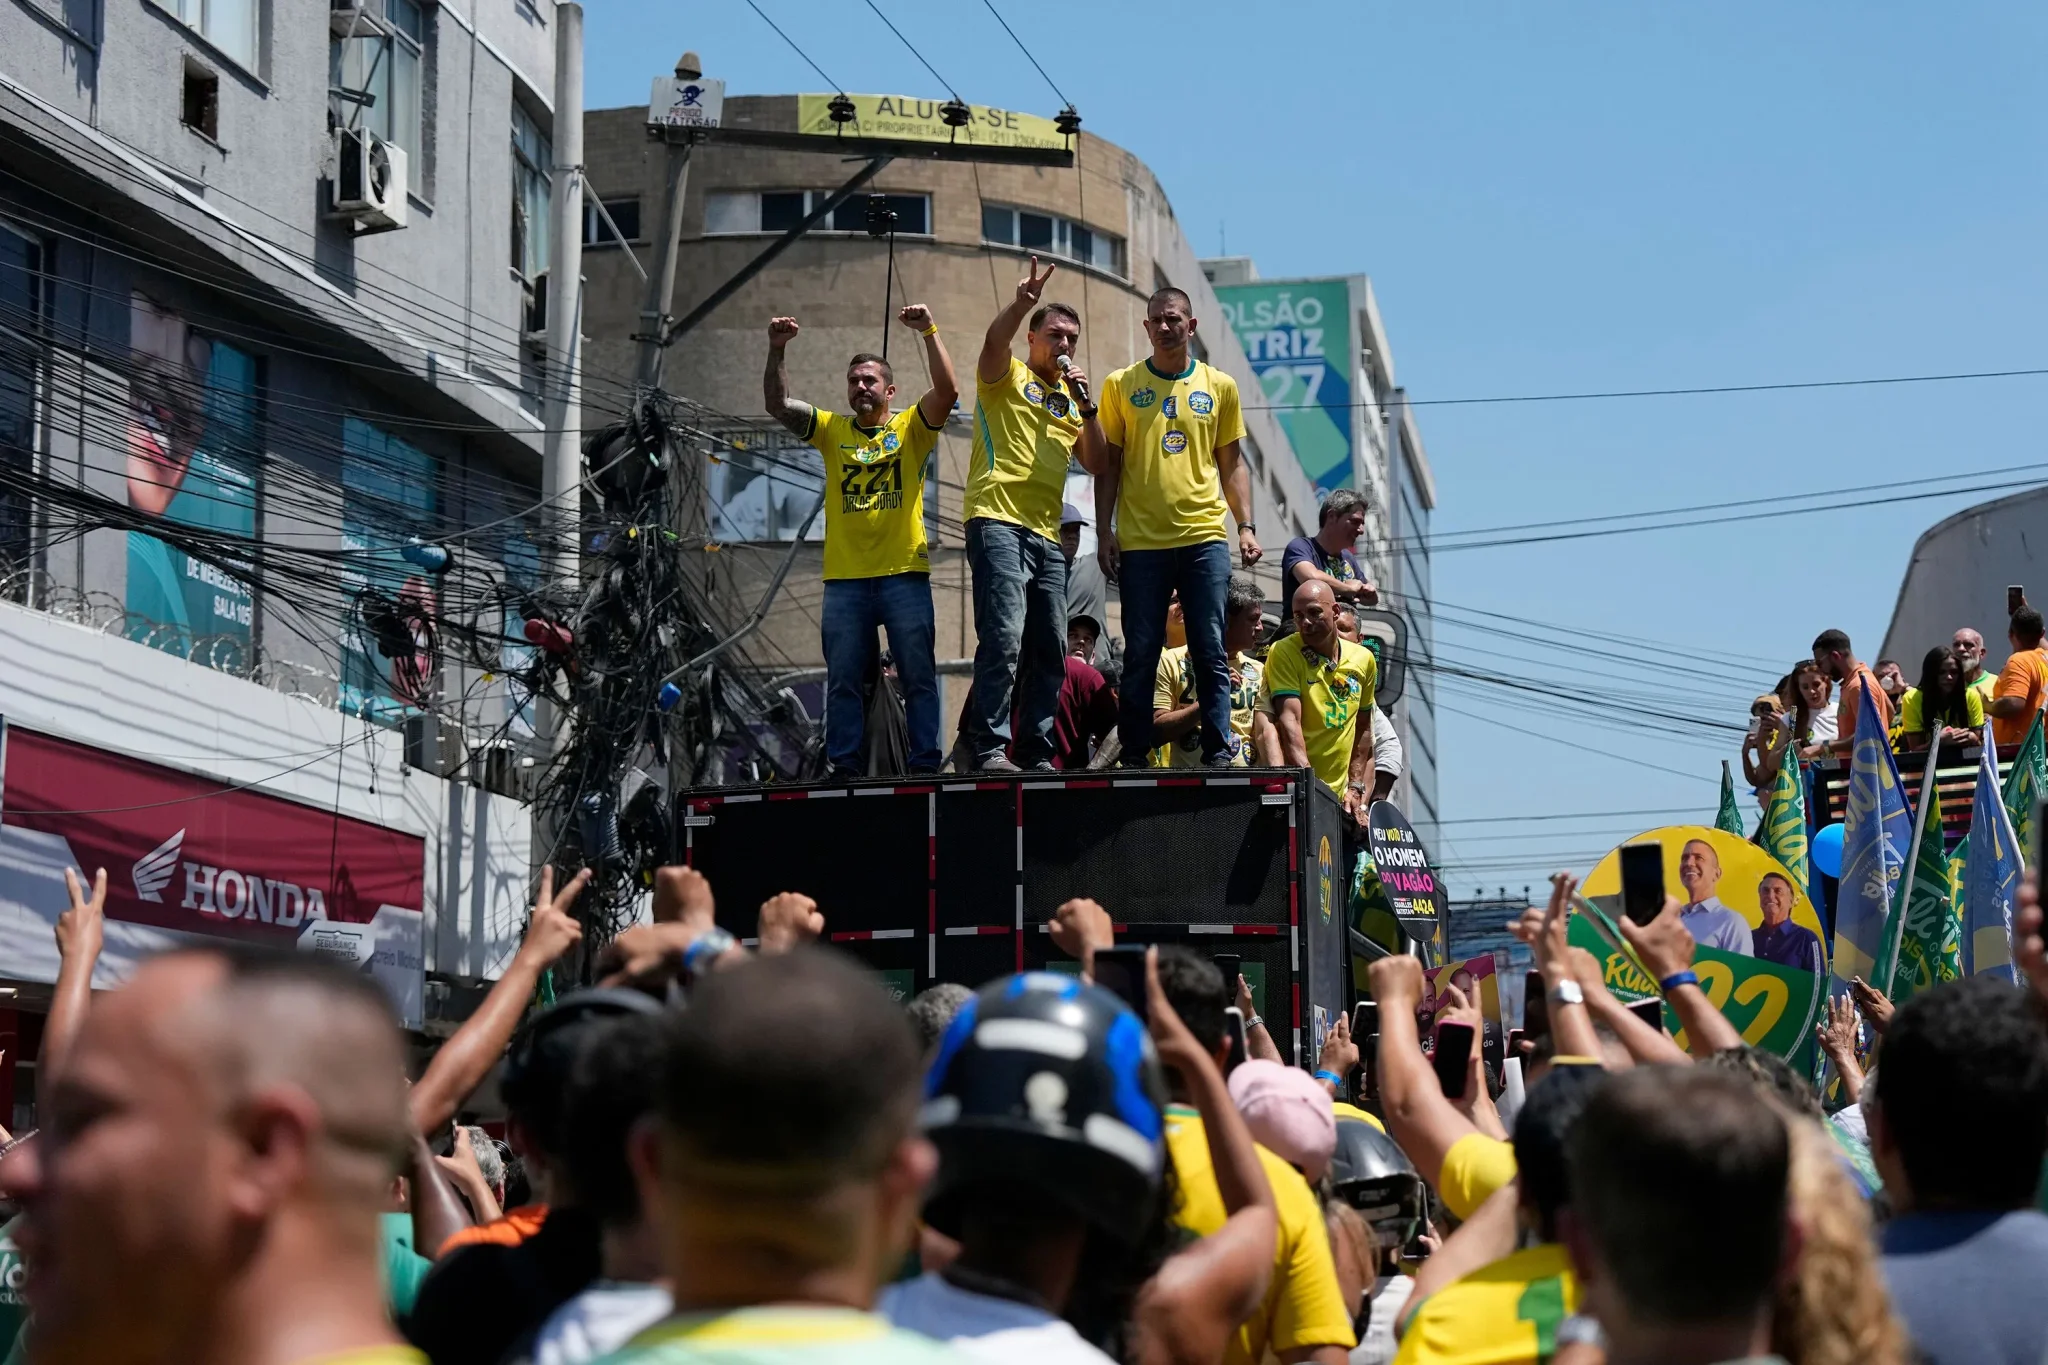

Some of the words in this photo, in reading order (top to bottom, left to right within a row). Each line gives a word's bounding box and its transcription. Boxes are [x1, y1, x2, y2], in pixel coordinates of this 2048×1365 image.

[653, 116, 680, 127] ALTA
[669, 106, 702, 118] PERIGO
[1243, 328, 1325, 360] TRIZ
[841, 458, 902, 495] 221
[187, 556, 199, 580] DE
[213, 595, 236, 621] SALA
[1373, 828, 1386, 841] MEU
[1386, 827, 1400, 842] VOTO
[1405, 830, 1414, 843] NO
[1374, 846, 1384, 866] O
[1384, 847, 1427, 868] HOMEM
[1381, 871, 1391, 883] DO
[1392, 868, 1434, 893] VAGÃO
[181, 861, 328, 928] HONDA
[1412, 898, 1435, 915] 4424
[315, 938, 357, 951] SEGURANÇA
